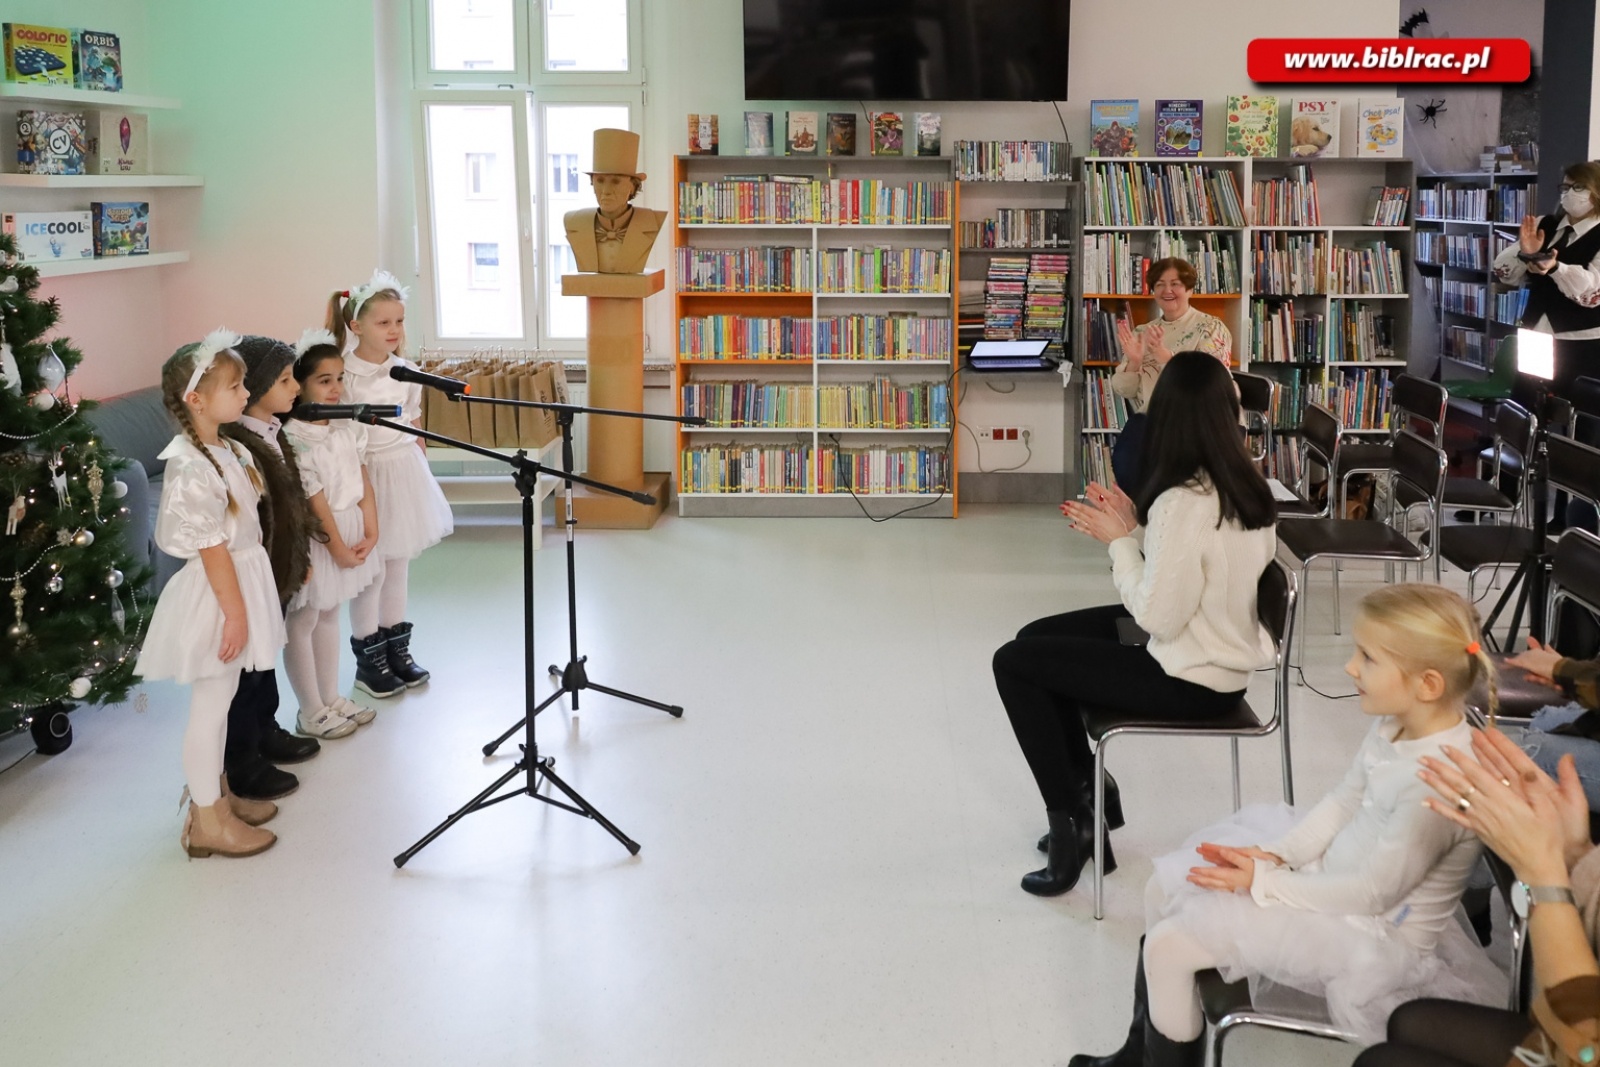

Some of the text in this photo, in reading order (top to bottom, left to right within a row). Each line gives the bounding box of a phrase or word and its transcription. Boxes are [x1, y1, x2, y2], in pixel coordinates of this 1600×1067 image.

[84, 34, 115, 47] ORBIS
[1298, 101, 1327, 112] PSY
[52, 134, 68, 149] CV
[25, 221, 84, 236] ICECOOL
